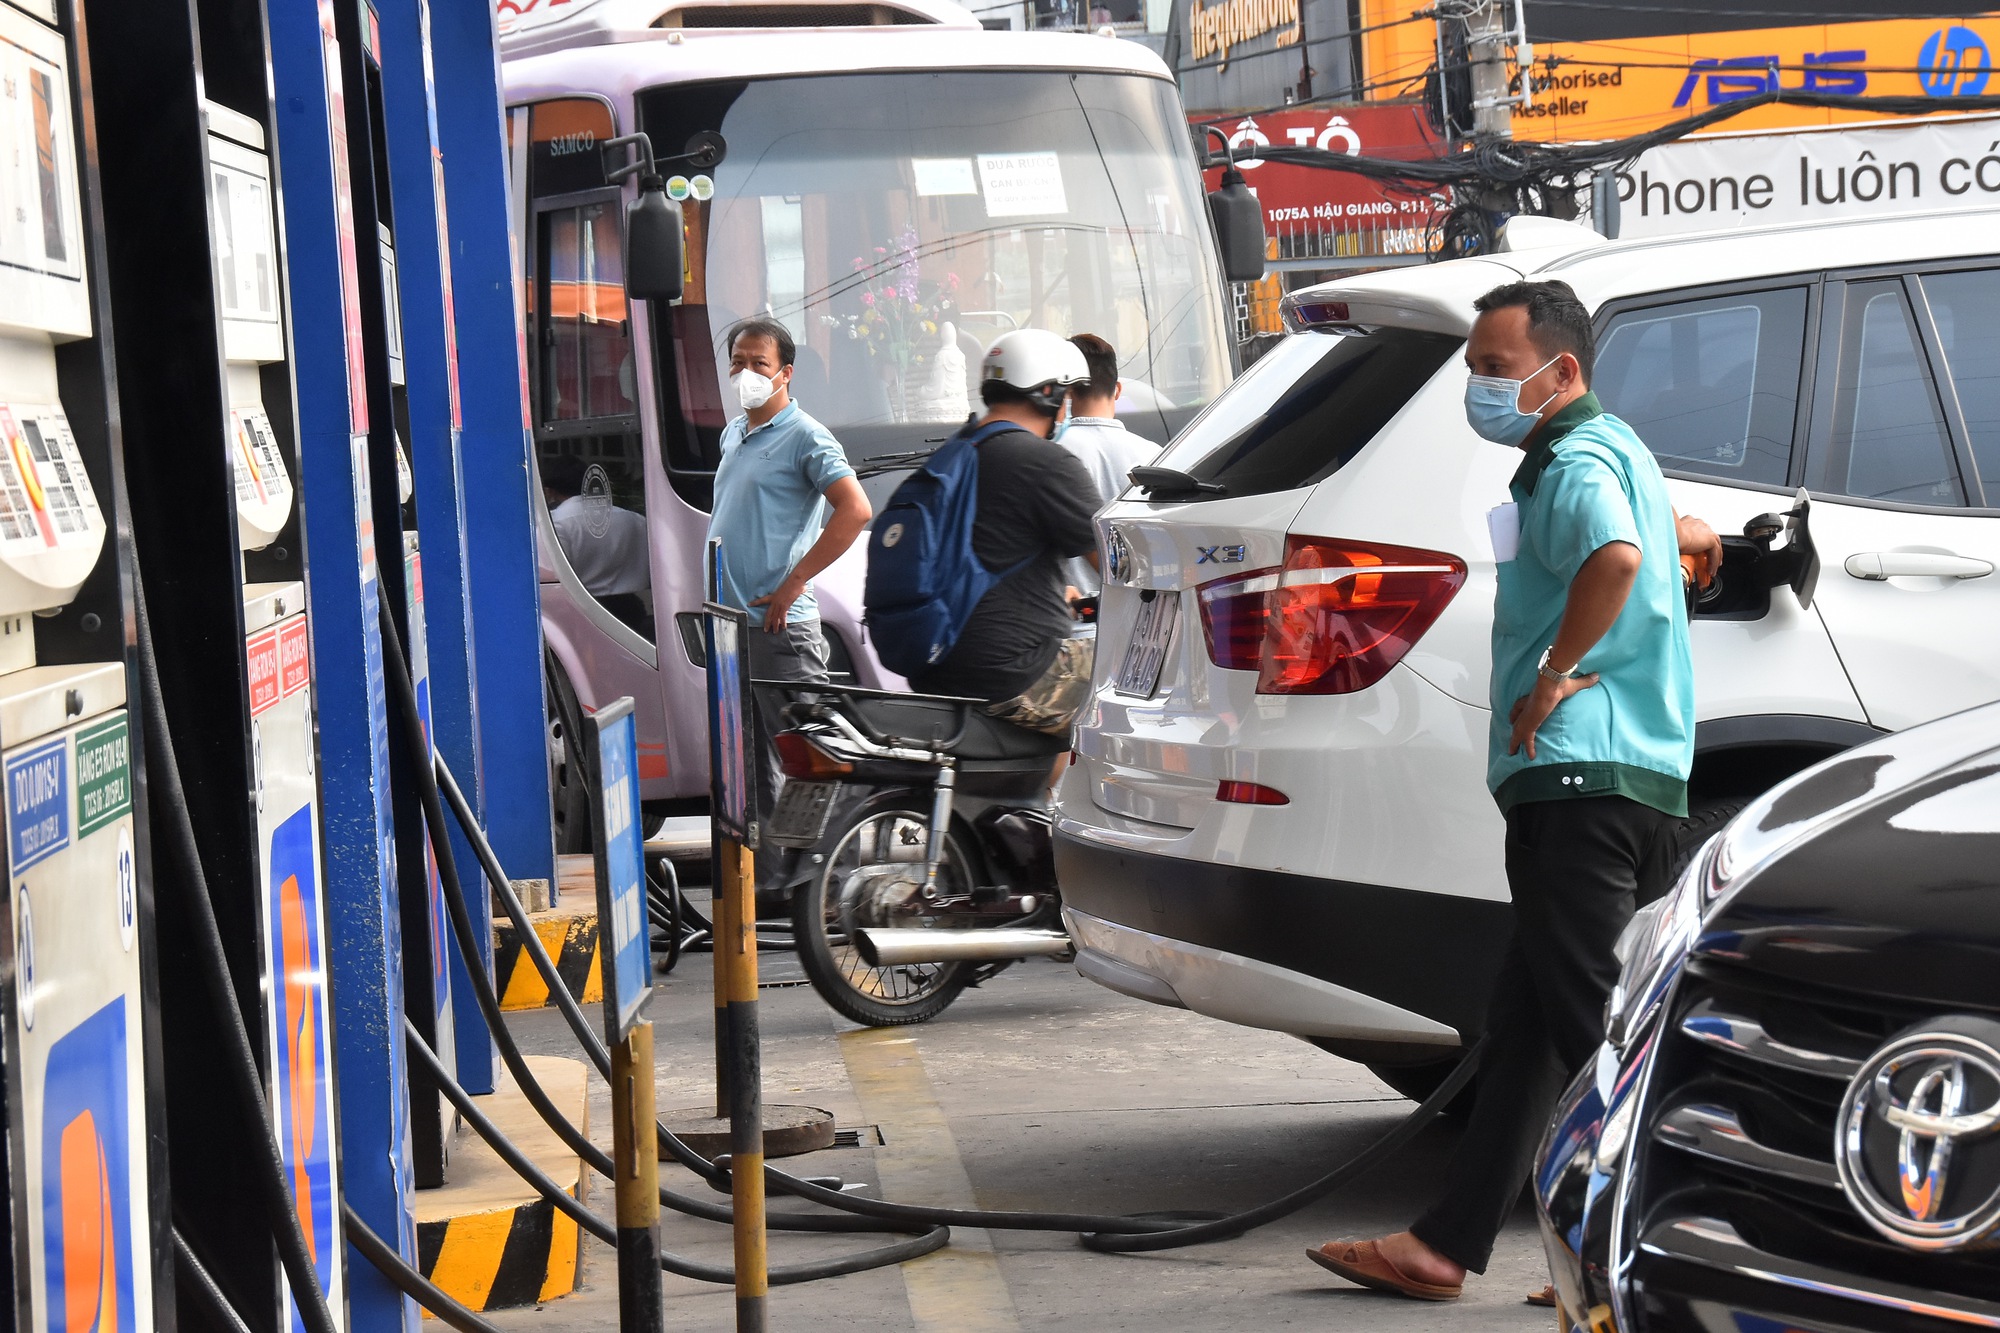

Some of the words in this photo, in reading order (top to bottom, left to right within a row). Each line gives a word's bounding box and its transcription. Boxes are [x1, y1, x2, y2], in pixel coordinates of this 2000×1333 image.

[1672, 50, 1867, 108] ASUS
[551, 130, 594, 156] SAMCO
[1800, 150, 1920, 206] luôn
[1940, 140, 2000, 196] có
[1268, 206, 1310, 221] 1075A
[1314, 202, 1342, 220] HẬU
[1346, 201, 1397, 216] GIANG,
[1195, 545, 1246, 564] X3
[119, 849, 132, 928] 13
